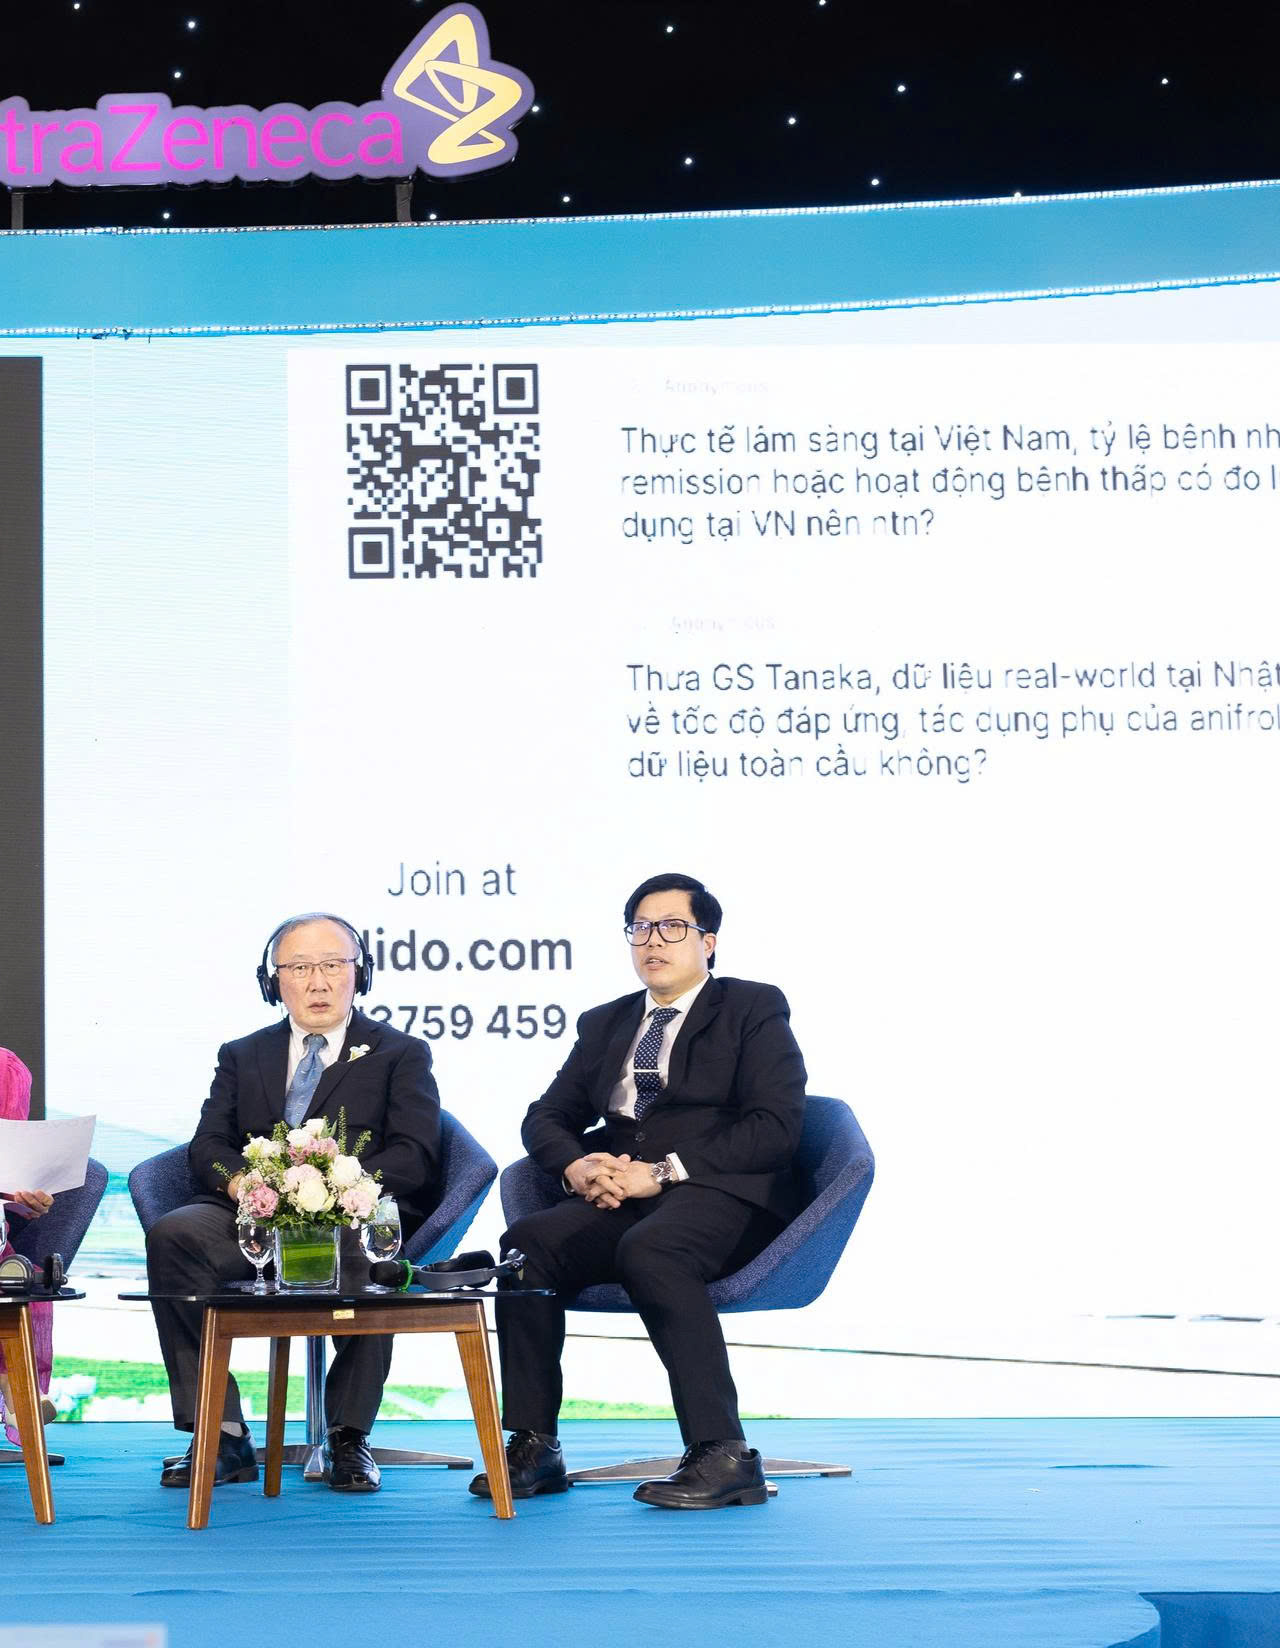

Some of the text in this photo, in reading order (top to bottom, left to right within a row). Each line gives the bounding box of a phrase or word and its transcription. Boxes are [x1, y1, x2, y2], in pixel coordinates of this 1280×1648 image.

[621, 427, 696, 458] Thực
[809, 424, 878, 460] sàng
[889, 425, 923, 456] tại
[934, 425, 991, 456] Việt
[1003, 424, 1076, 455] Nam,
[1129, 424, 1151, 454] lệ
[622, 468, 760, 495] remission
[774, 469, 844, 499] hoặc
[856, 468, 920, 498] hoạt
[933, 466, 1004, 500] động
[1178, 463, 1211, 491] có
[1224, 465, 1260, 491] đo
[623, 508, 934, 544] dụng tại VN nên ntn?
[626, 665, 700, 691] Thưa
[713, 663, 754, 691] GS
[765, 664, 880, 696] Tanaka,
[943, 662, 992, 694] liệu
[1005, 661, 1155, 688] real-world
[1167, 661, 1201, 693] tại
[777, 706, 830, 741] đáp
[919, 704, 964, 733] tác
[976, 705, 1048, 739] dụng
[1062, 705, 1113, 738] phụ
[1128, 704, 1177, 731] của
[679, 750, 728, 783] liệu
[739, 748, 802, 777] toàn
[881, 748, 986, 784] không?
[388, 861, 517, 896] Join at
[363, 927, 572, 972] lido.com
[360, 1004, 567, 1040] 3759 459
